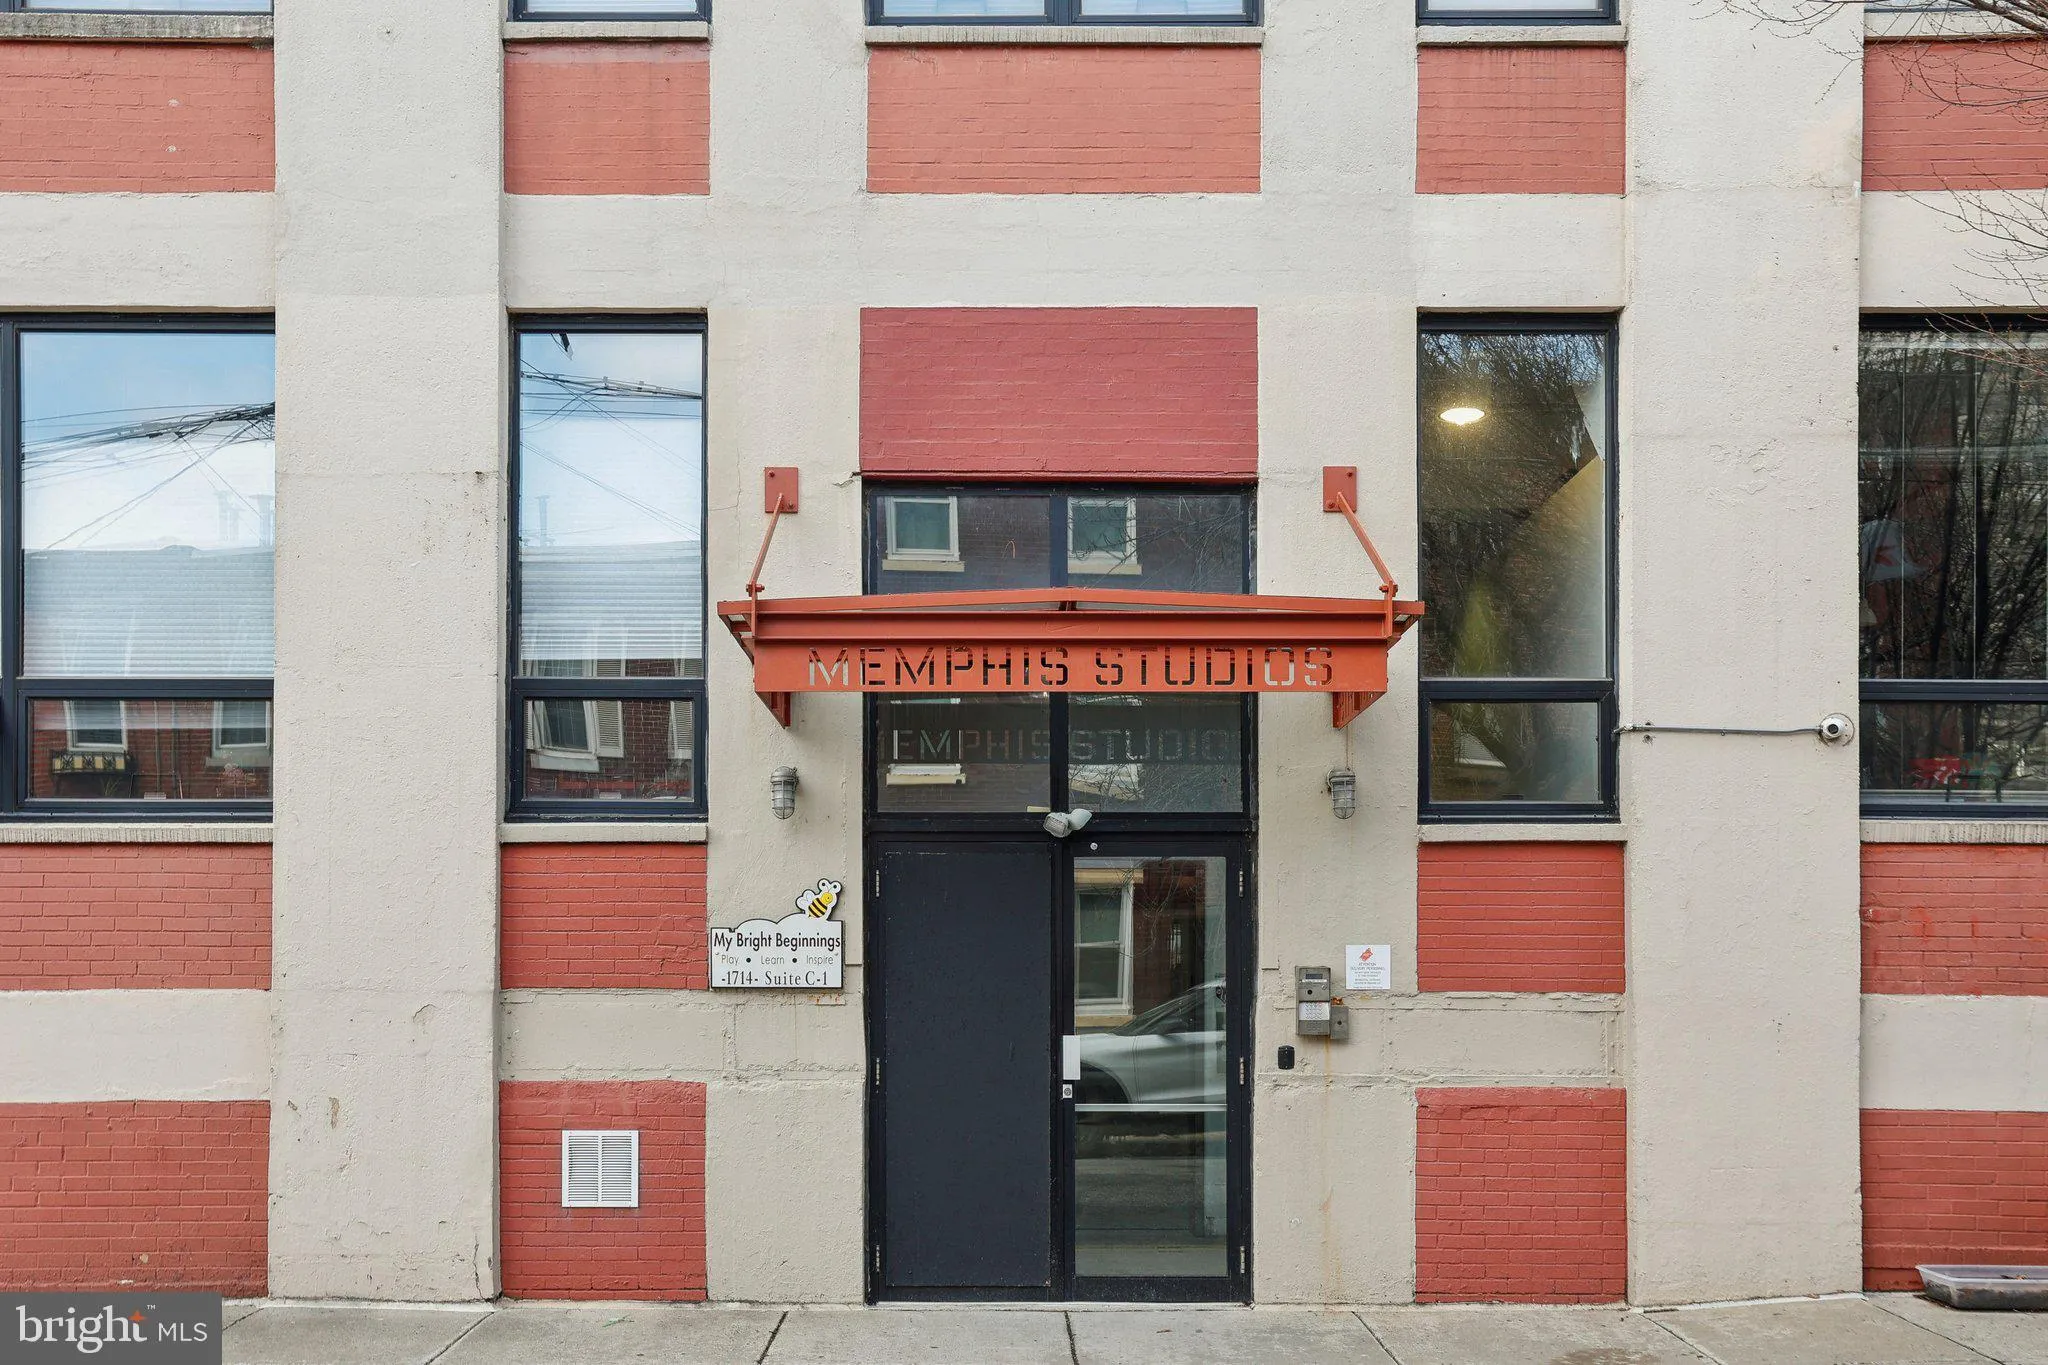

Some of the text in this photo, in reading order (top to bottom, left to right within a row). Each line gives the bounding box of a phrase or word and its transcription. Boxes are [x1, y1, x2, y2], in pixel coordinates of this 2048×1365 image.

[808, 647, 1333, 686] MEMPHIS STUDIOS
[713, 931, 841, 952] My Bright Beginnings
[721, 954, 834, 967] Play Learn Inspire
[765, 970, 801, 986] Suite
[805, 970, 828, 986] C-1
